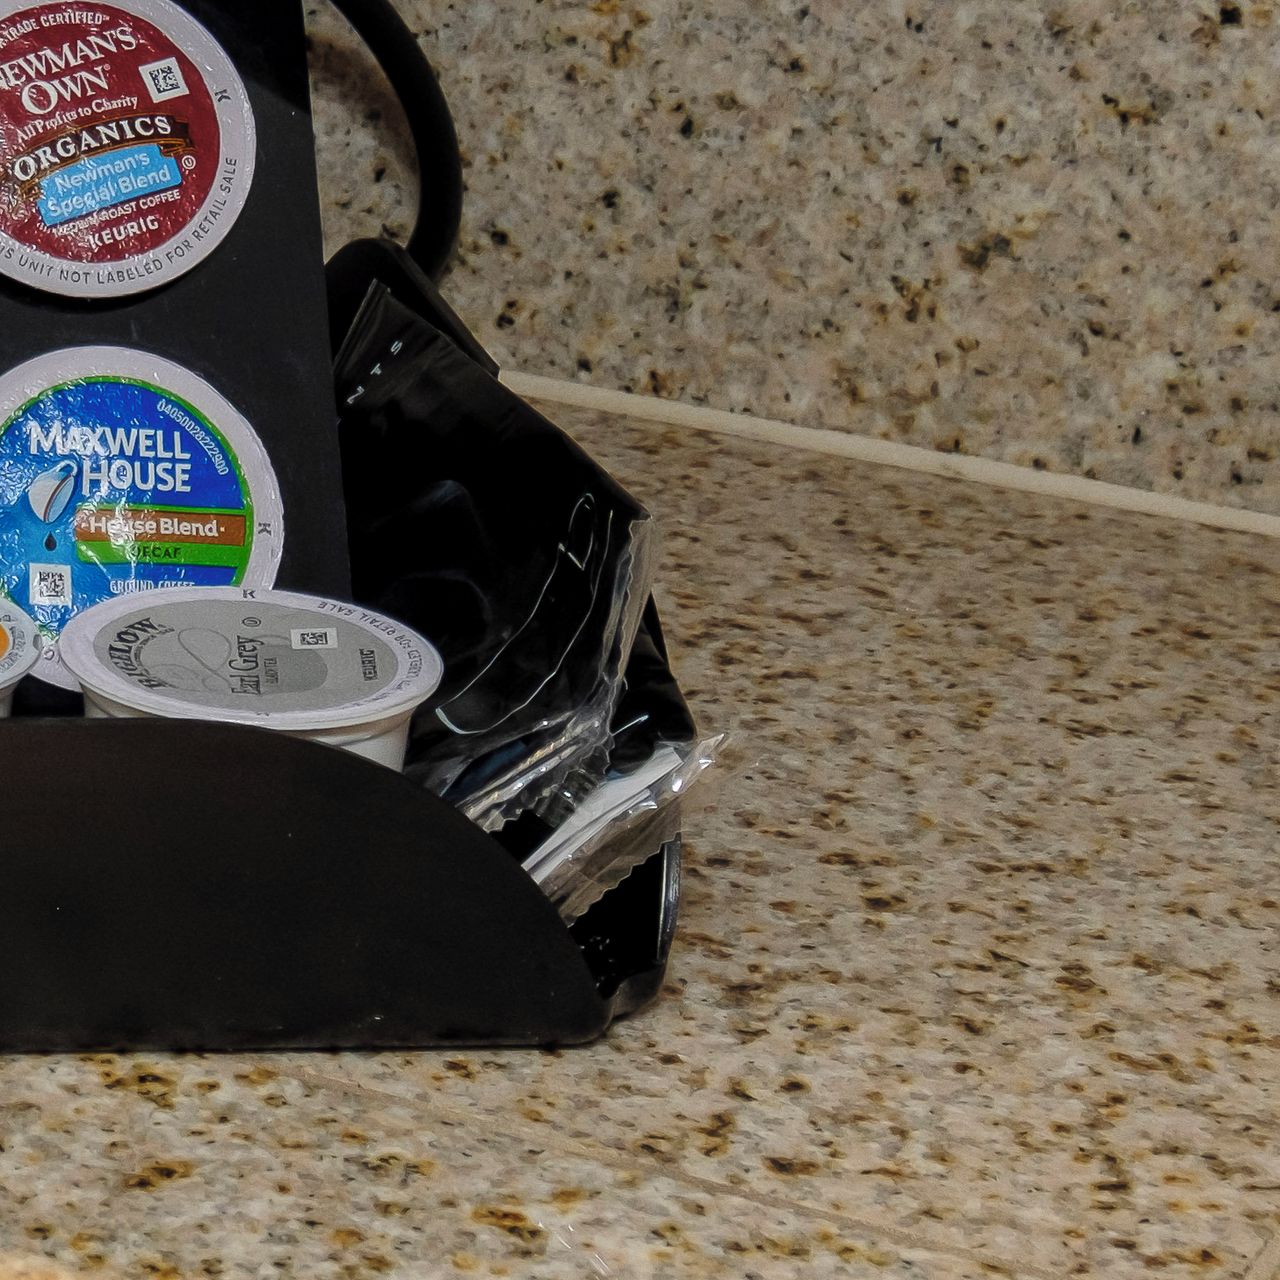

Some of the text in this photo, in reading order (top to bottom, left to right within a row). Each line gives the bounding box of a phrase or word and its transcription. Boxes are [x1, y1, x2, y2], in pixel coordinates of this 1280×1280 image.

[4, 18, 40, 42] TRADE
[16, 94, 139, 143] All Profits to Charity
[13, 115, 173, 182] ORGANICS
[46, 164, 172, 218] Special Blend
[54, 151, 151, 193] Newman's
[18, 254, 52, 277] UNIT
[59, 269, 91, 285] NOT
[96, 258, 164, 285] LABELED
[165, 239, 194, 265] FOR
[192, 199, 227, 242] RETAIL
[219, 156, 239, 195] SALE
[100, 201, 138, 222] ROAST
[139, 188, 182, 211] COFFEE
[89, 214, 161, 251] KEURIG
[28, 419, 192, 461] MAXWELL
[81, 457, 192, 497] HOUSE
[89, 516, 219, 537] House Blend
[132, 544, 183, 560] DECAF
[317, 600, 355, 618] SALE
[107, 616, 159, 690] BIGELOW
[228, 634, 266, 696] Earl Grey
